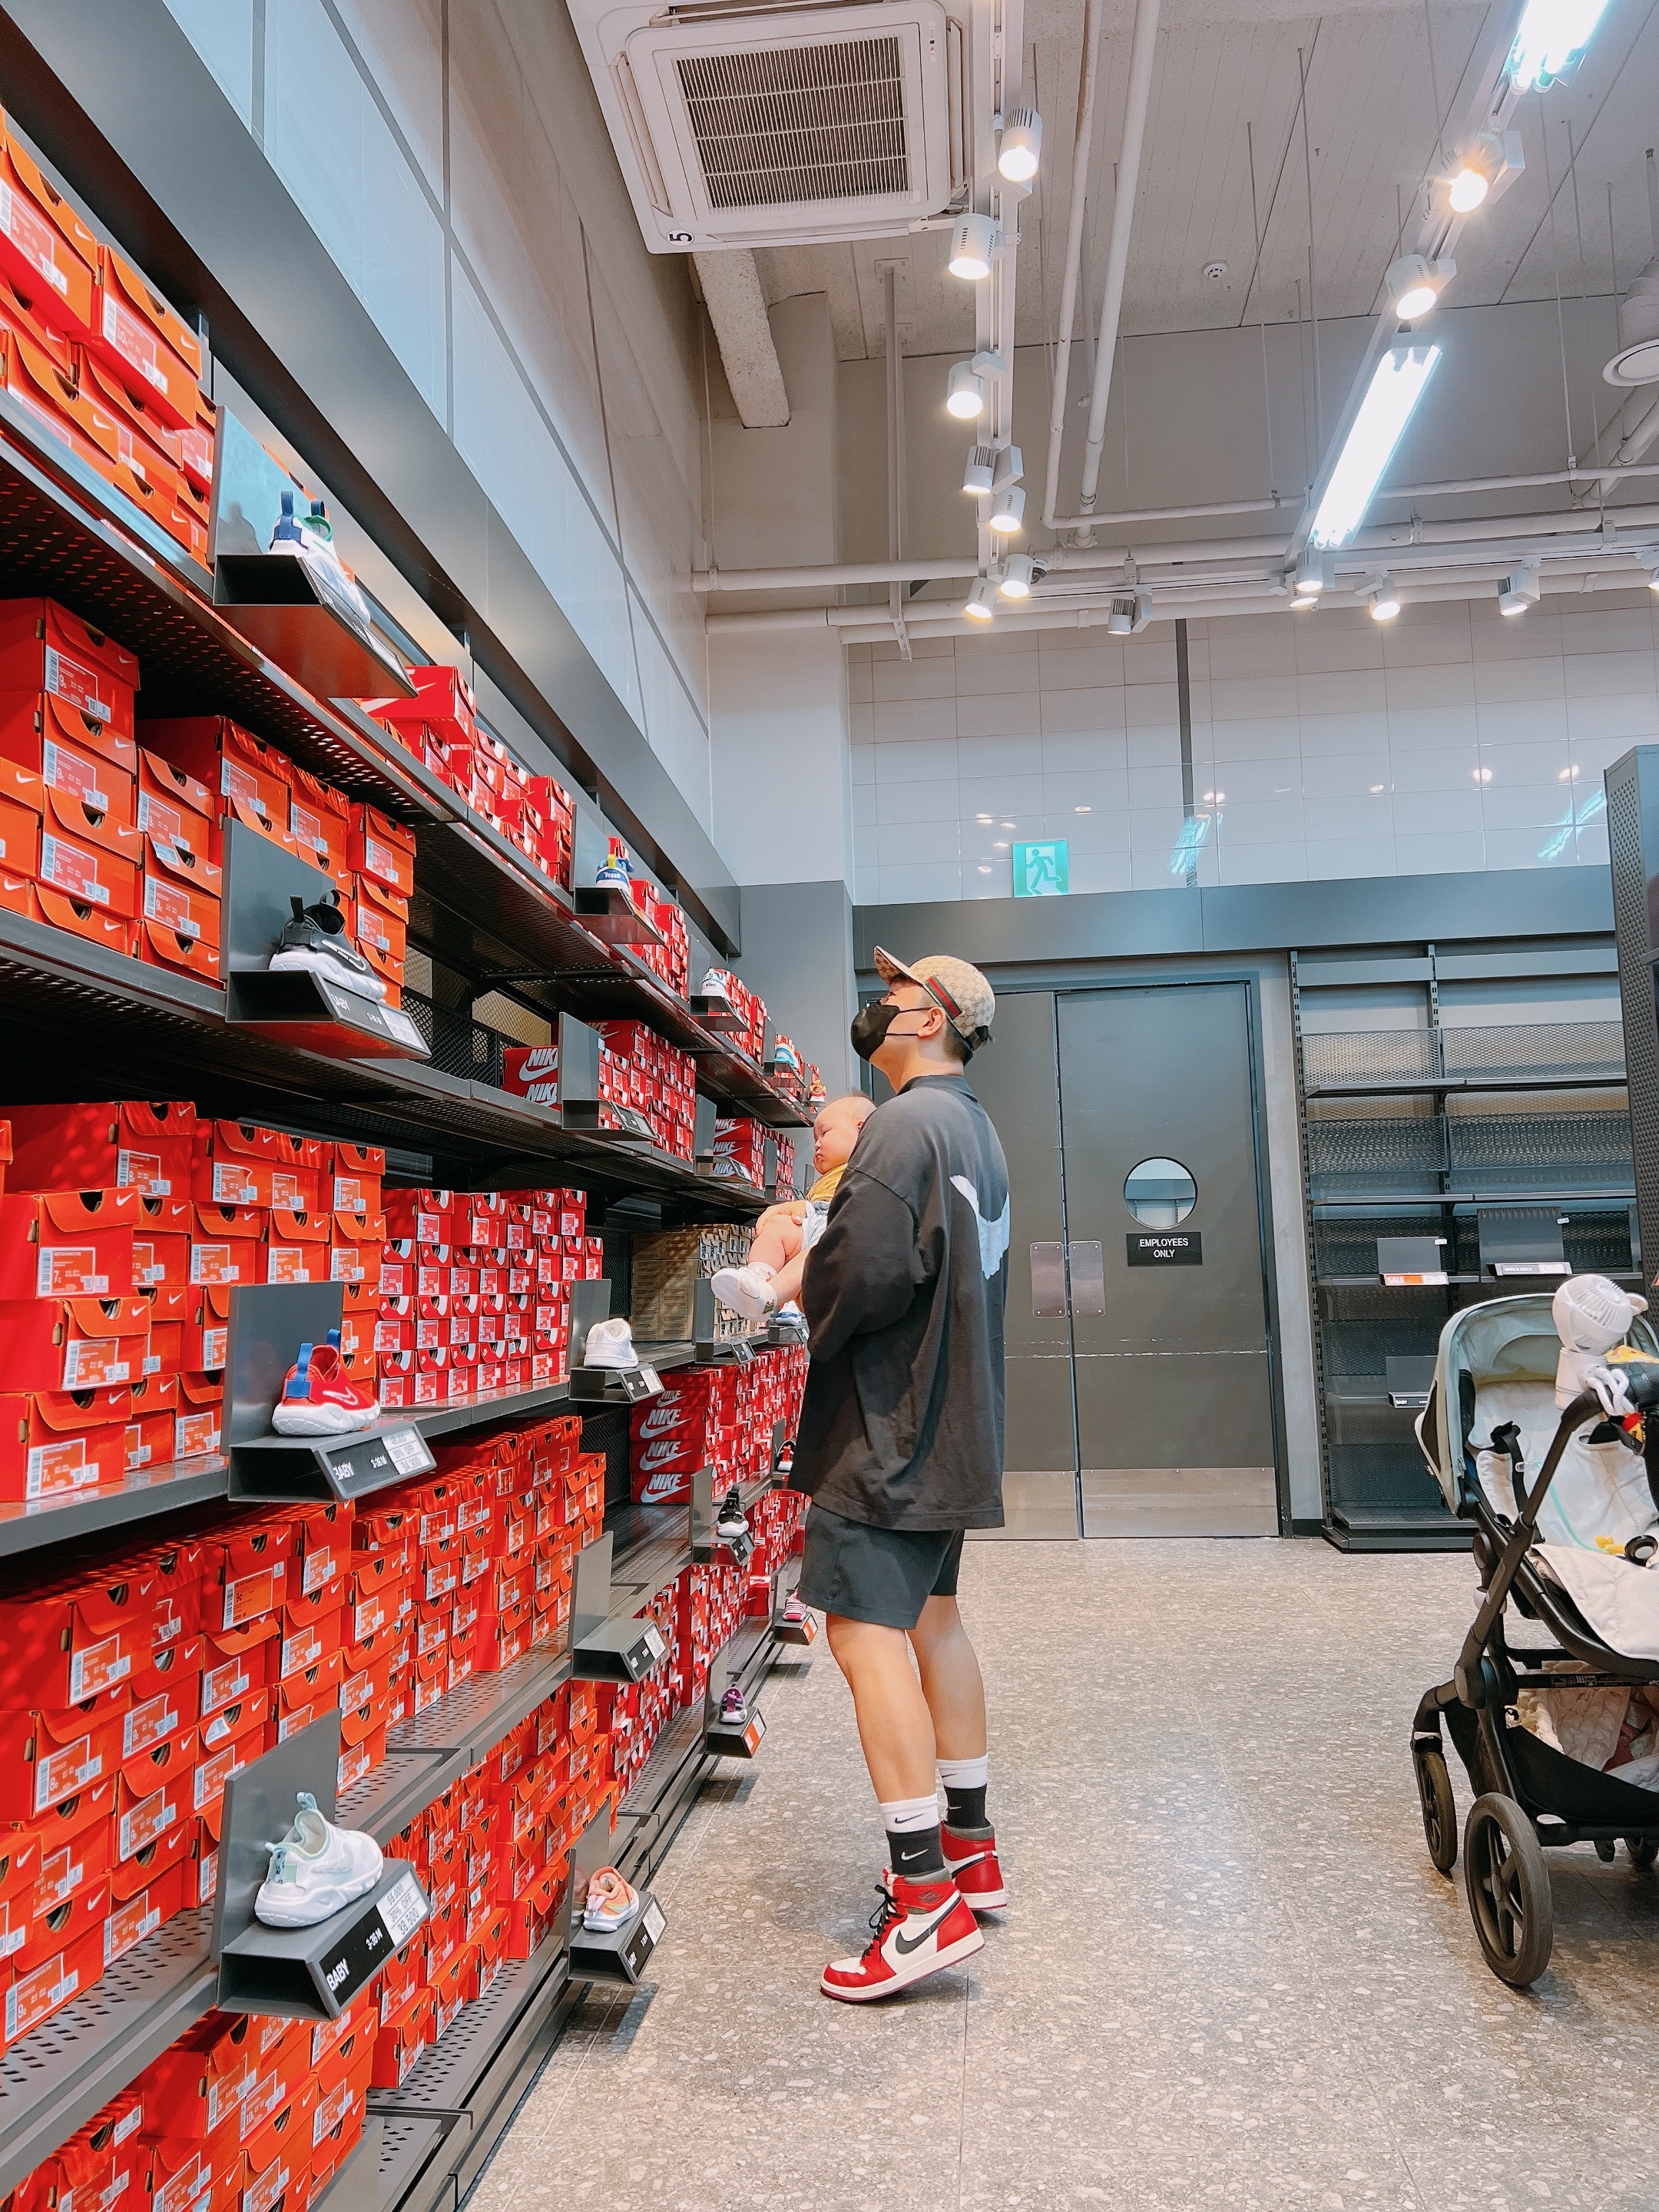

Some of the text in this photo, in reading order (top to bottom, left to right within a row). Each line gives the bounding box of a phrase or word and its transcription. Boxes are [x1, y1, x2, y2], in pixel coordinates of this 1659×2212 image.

[669, 233, 693, 242] 5
[527, 1048, 558, 1066] NIK
[525, 1083, 557, 1101] NIK
[714, 1118, 737, 1130] NIKE
[713, 1141, 736, 1151] NIKE
[1139, 1238, 1189, 1247] EMPLOYEES
[1153, 1249, 1175, 1258] ONLY
[661, 1390, 680, 1399] NIKE
[647, 1409, 681, 1425] NIKE
[646, 1441, 680, 1457] NIKE
[647, 1474, 683, 1489] NIKE
[401, 1893, 412, 1909] OFF
[397, 1907, 419, 1936] 38,500
[326, 1958, 350, 1992] BABY
